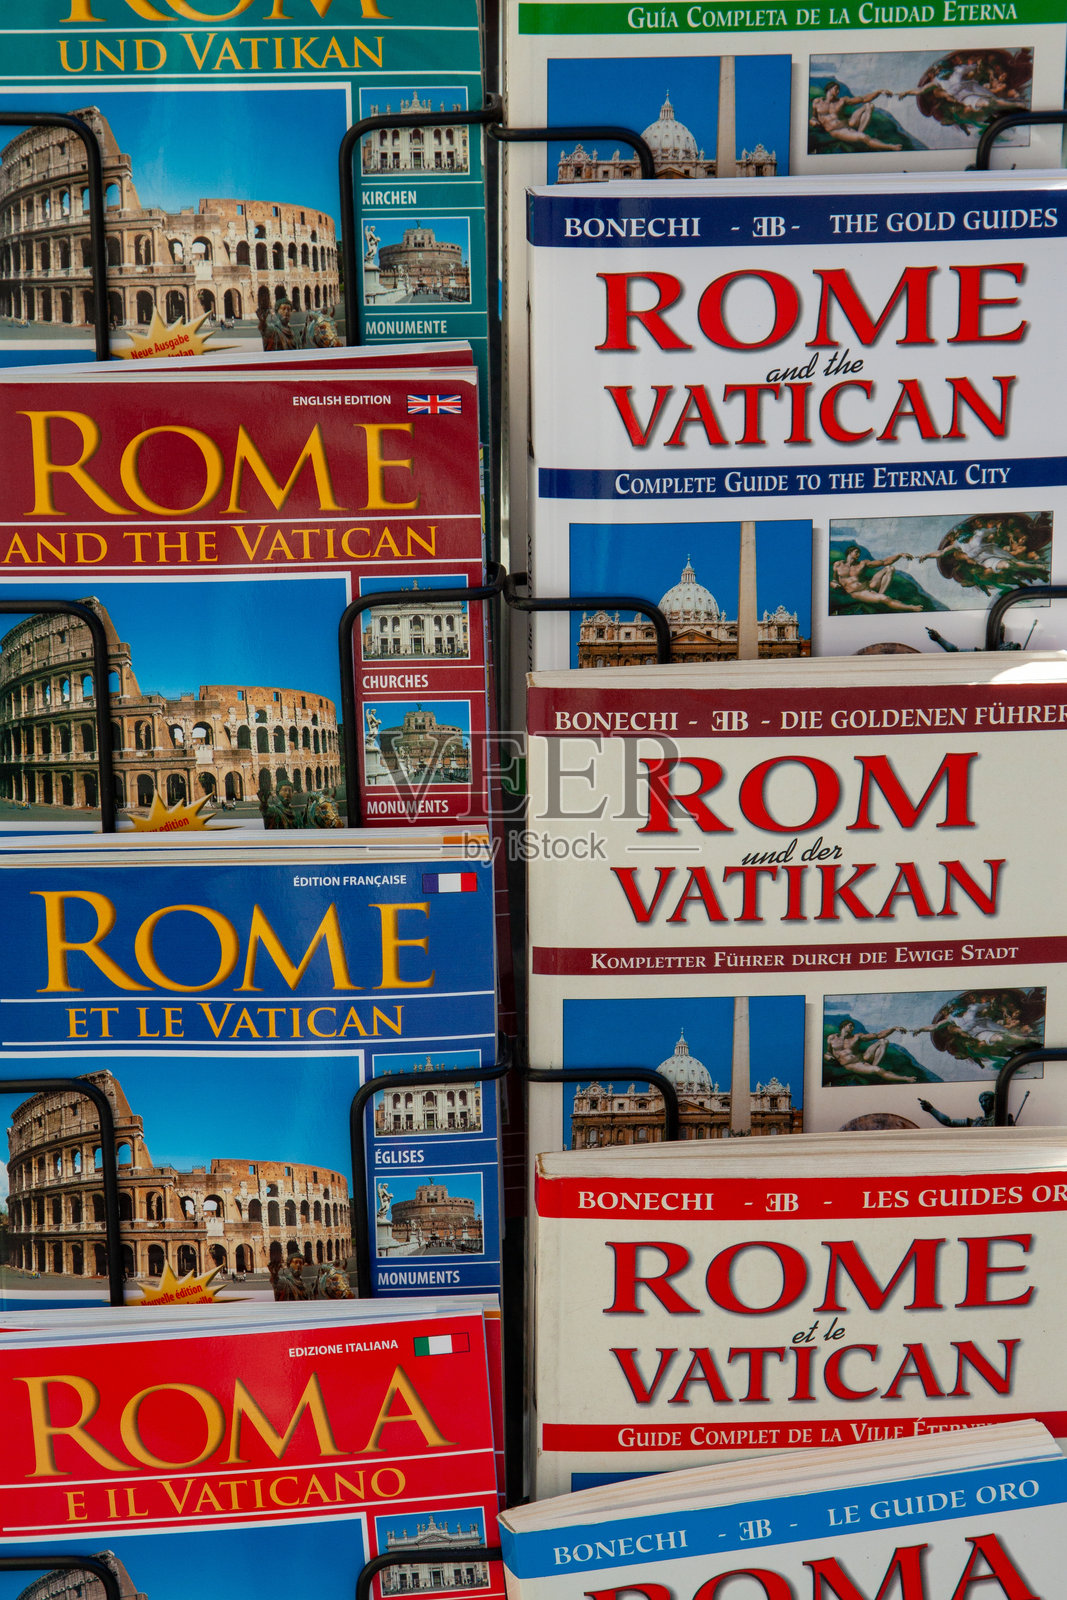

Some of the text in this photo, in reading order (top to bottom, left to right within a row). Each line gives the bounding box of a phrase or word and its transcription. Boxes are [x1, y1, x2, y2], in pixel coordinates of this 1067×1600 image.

[687, 7, 787, 27] COMPLETA
[797, 10, 819, 24] DE
[830, 9, 849, 24] LA
[859, 3, 934, 23] CIUDAD
[944, 1, 1016, 20] ETERNA
[57, 34, 382, 72] UND VATIKAN
[363, 191, 416, 204] KIRCHEN
[565, 218, 700, 237] BONECHI
[830, 214, 878, 233] THE
[887, 212, 955, 232] GOLD
[964, 209, 1057, 229] GUIDES
[597, 264, 1026, 349] ROME
[366, 321, 447, 334] MONUMENTE
[131, 349, 154, 359] Neue
[154, 334, 190, 353] Ausgabe
[766, 349, 864, 383] and the
[293, 396, 390, 405] ENGLISH EDITION
[607, 376, 1015, 445] VATICAN
[16, 411, 417, 516] ROME
[615, 464, 1010, 494] COMPLETE GUIDE TO THE ETERNAL CITY
[2, 522, 437, 563] AND THE VATICAN
[363, 675, 428, 688] CHURCHES
[555, 712, 678, 733] BONECHI
[781, 711, 822, 729] DIE
[831, 708, 967, 728] GOLDENEN
[975, 703, 1067, 724] FÜHRER
[368, 800, 448, 814] MONUMENTS
[640, 753, 977, 832] ROM
[160, 817, 190, 832] edition
[741, 836, 843, 865] und der
[294, 875, 406, 887] ÉDITION FRANÇAISE
[612, 860, 1005, 921] VATIKAN
[30, 891, 432, 992] ROME
[591, 945, 1018, 968] KOMPLETTER FÜHRER DURCH DIE EWIGE STADT
[67, 1003, 402, 1037] ET LE VATICAN
[376, 1149, 424, 1163] ÉGLISES
[579, 1192, 713, 1210] BONECHI
[863, 1191, 908, 1208] LES
[919, 1187, 1022, 1207] GUIDES
[379, 1271, 460, 1285] MONUMENTS
[606, 1234, 1033, 1313] ROME
[175, 1284, 203, 1300] édition
[792, 1317, 846, 1344] et le
[289, 1340, 398, 1357] EDIZIONE ITALIANA
[614, 1339, 1020, 1402] VATICAN
[14, 1366, 454, 1478] ROMA
[618, 1428, 681, 1447] GUIDE
[691, 1427, 780, 1445] COMPLET
[789, 1429, 812, 1443] DE
[822, 1429, 842, 1442] LA
[846, 1423, 903, 1442] VILLE
[65, 1467, 406, 1520] E IL VATICANO
[554, 1530, 689, 1566] BONECHI
[828, 1505, 860, 1525] LE
[871, 1490, 967, 1522] GUIDE
[976, 1480, 1039, 1503] ORO
[584, 1533, 1042, 1600] MA
